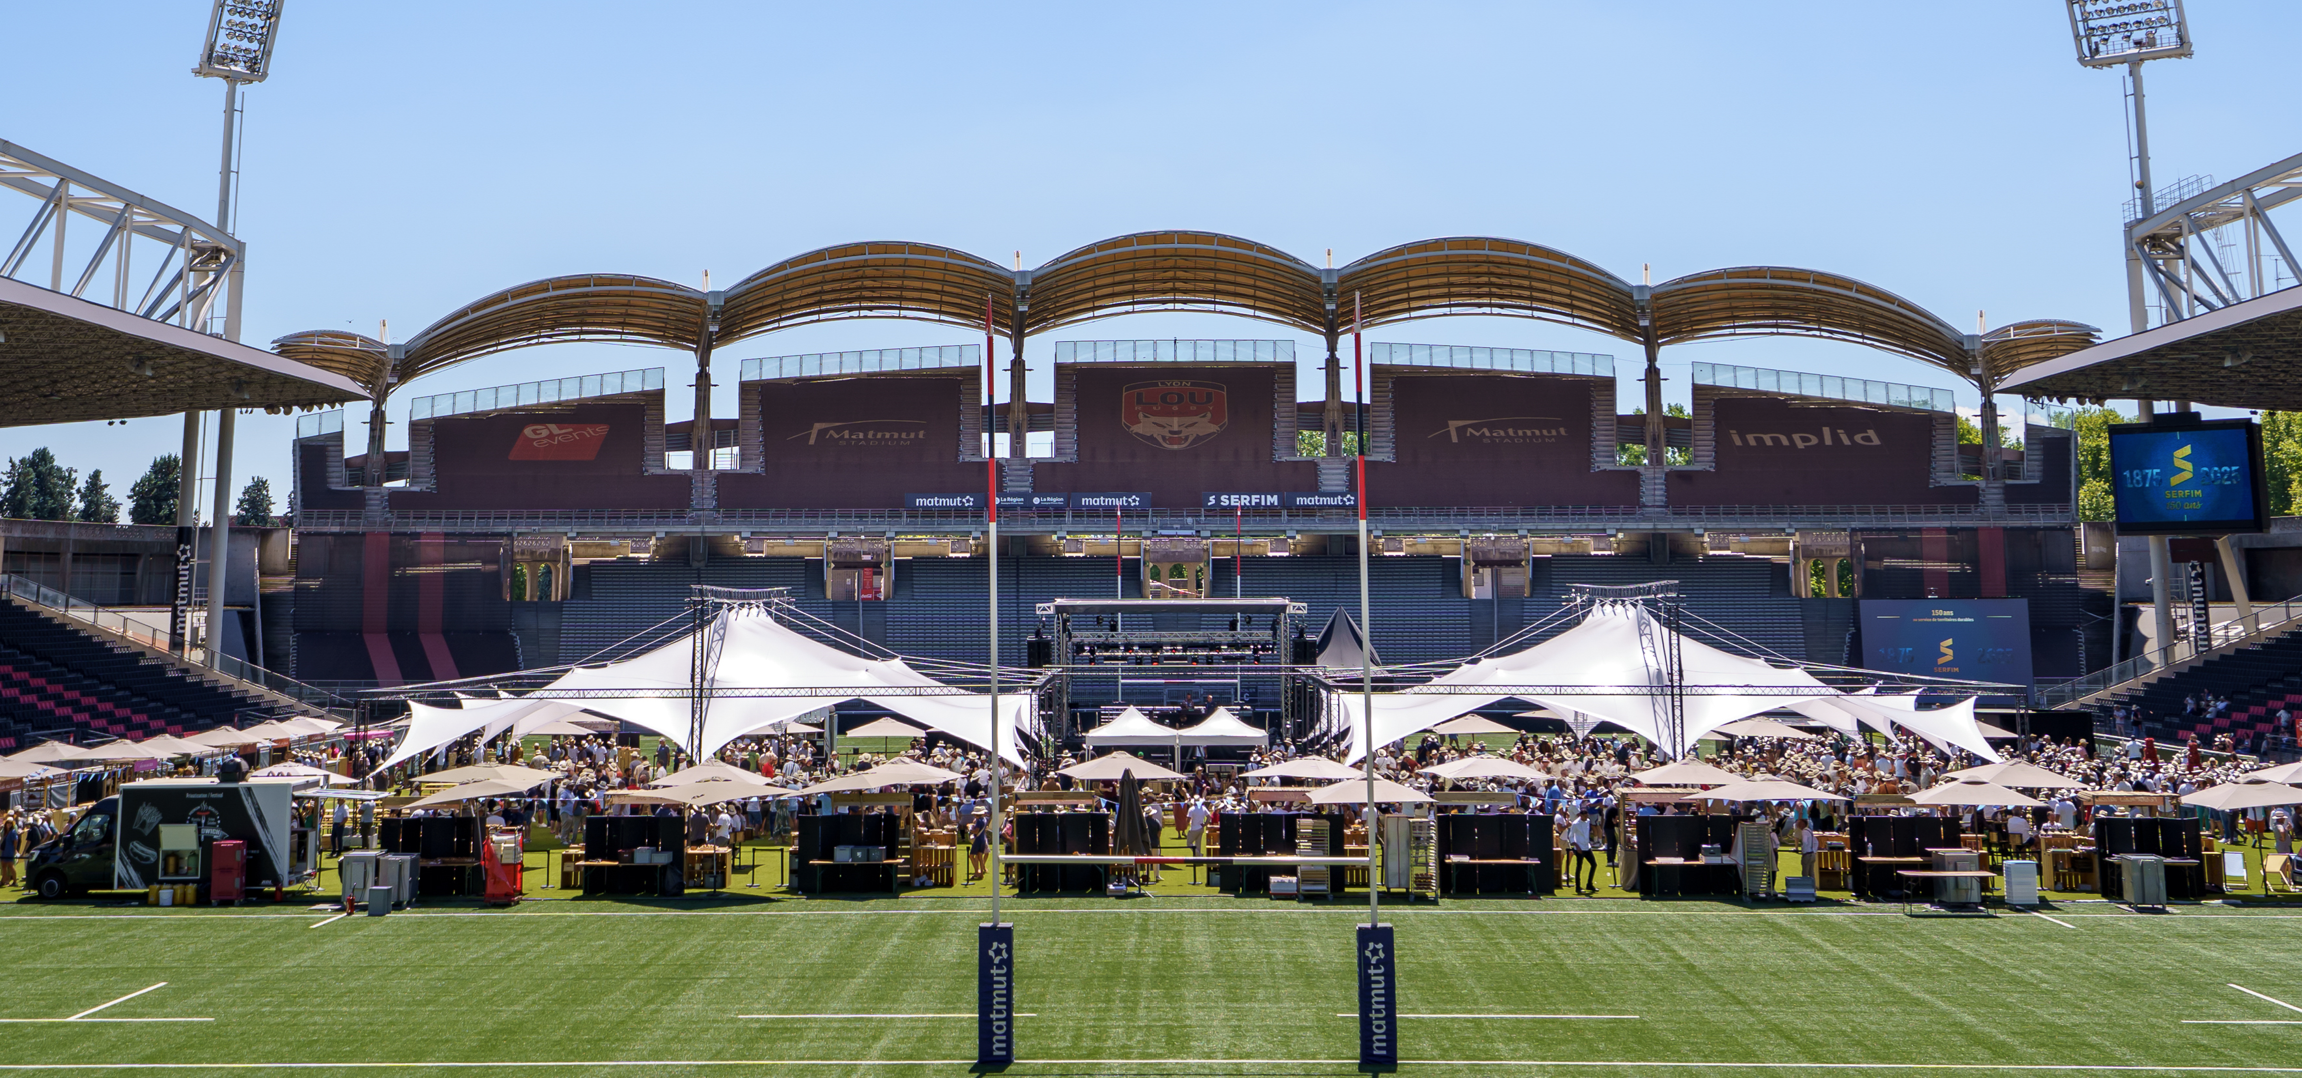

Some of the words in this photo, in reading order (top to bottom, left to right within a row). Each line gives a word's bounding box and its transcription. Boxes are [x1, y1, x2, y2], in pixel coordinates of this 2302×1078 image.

[1135, 391, 1214, 406] LOU
[523, 424, 574, 439] GL
[533, 425, 609, 448] events
[825, 429, 926, 439] Matmut
[1466, 427, 1569, 437] Matmut
[1729, 426, 1882, 449] implid
[2123, 468, 2163, 488] 1875
[2200, 466, 2241, 486] 2025
[915, 496, 962, 507] matmut
[1081, 496, 1128, 506] matmut
[1220, 494, 1278, 506] SERFIM
[1296, 495, 1343, 506] matmut
[2165, 490, 2203, 499] SERFIM
[175, 561, 190, 634] matmut
[2190, 577, 2209, 653] matmut
[1243, 693, 1250, 701] C
[989, 964, 1007, 1056] matmut
[1367, 964, 1387, 1055] matmut
